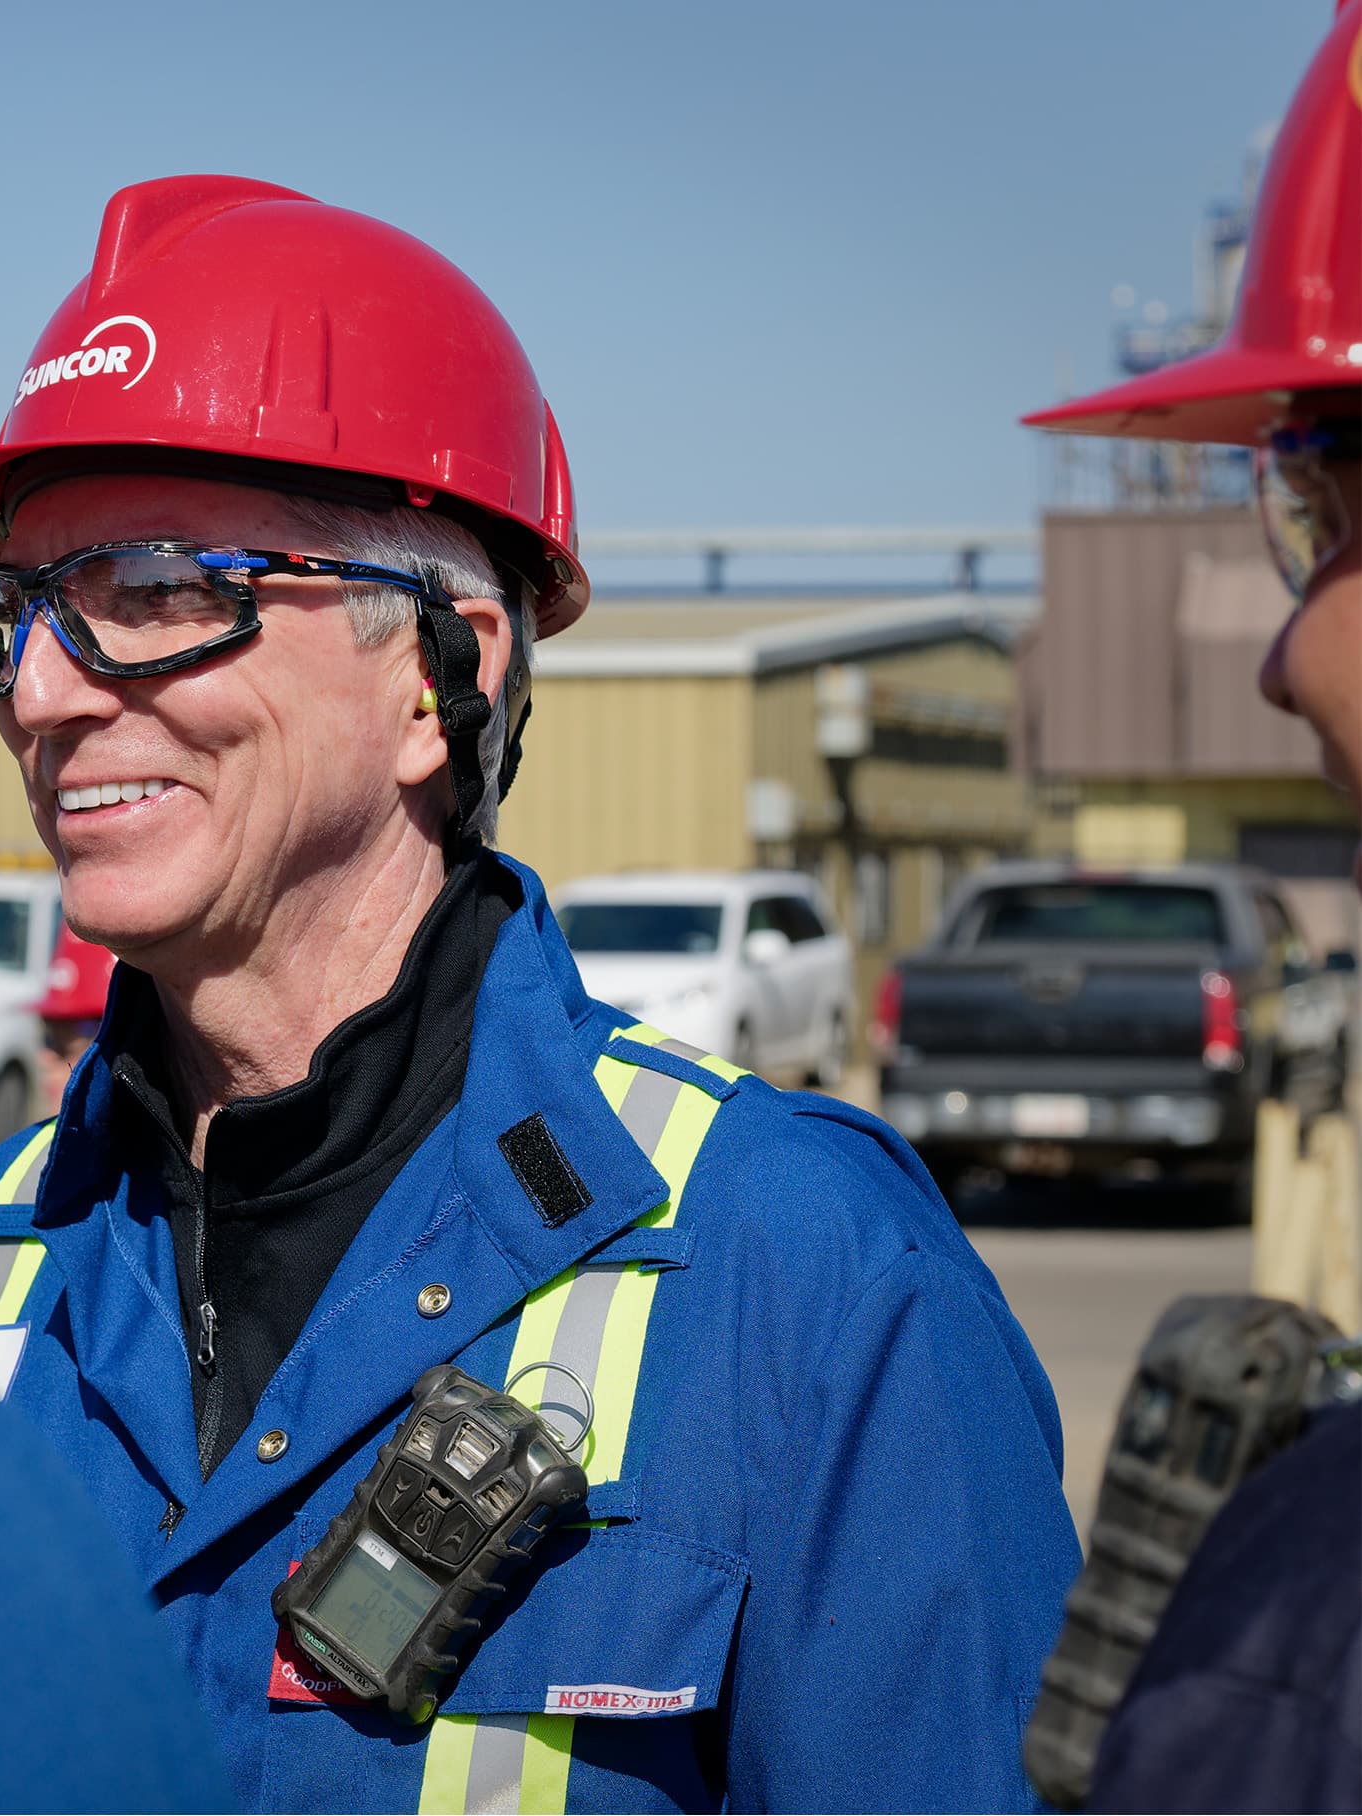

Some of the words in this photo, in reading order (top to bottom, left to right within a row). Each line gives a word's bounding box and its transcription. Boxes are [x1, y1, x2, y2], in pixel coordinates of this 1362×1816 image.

[14, 345, 132, 407] SUNCOR
[288, 553, 305, 564] 3M
[304, 1632, 327, 1653] MSA
[328, 1652, 354, 1675] ALTAIR
